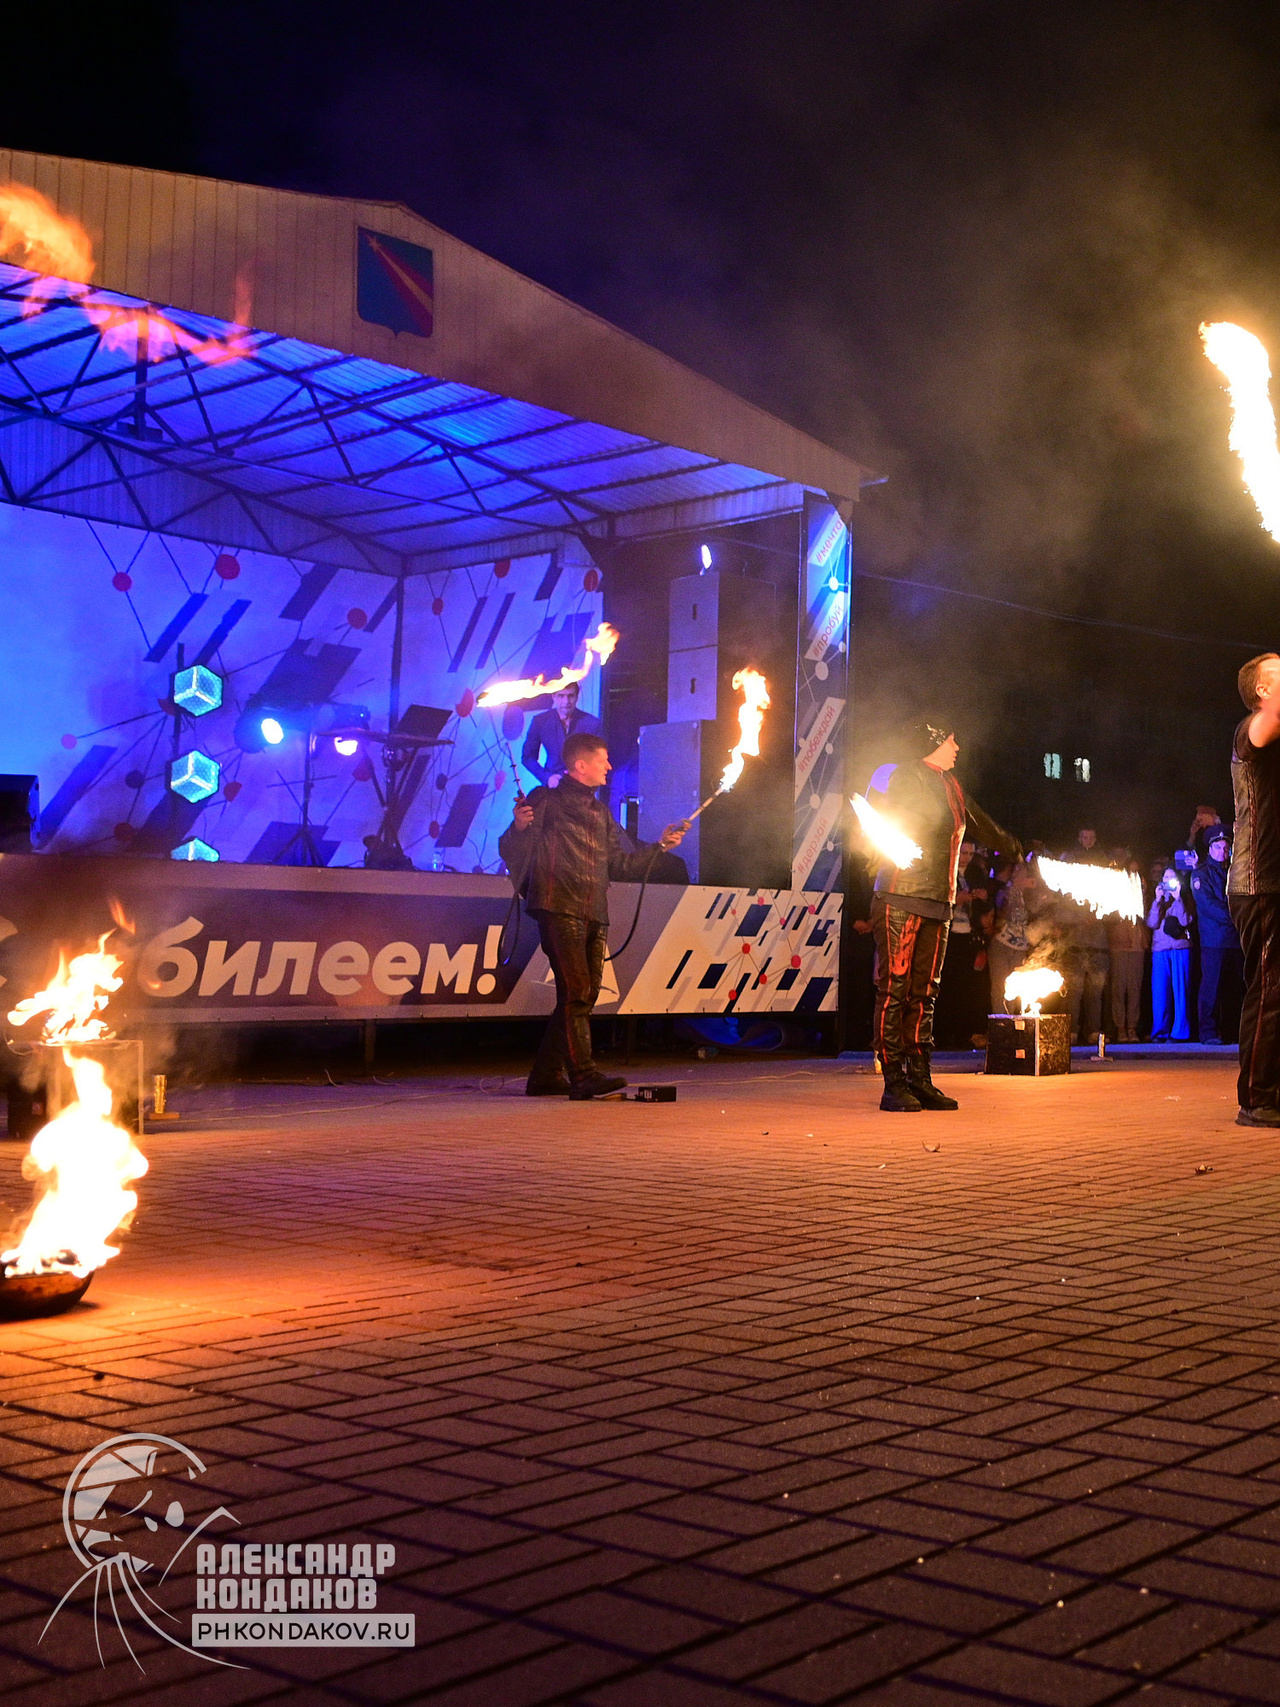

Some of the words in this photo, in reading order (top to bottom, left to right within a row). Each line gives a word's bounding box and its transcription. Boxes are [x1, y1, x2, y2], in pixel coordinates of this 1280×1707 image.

[812, 604, 844, 657] #пробуй
[797, 705, 836, 774] #побеждай
[797, 816, 828, 875] #дерзай
[136, 916, 504, 997] билеем!
